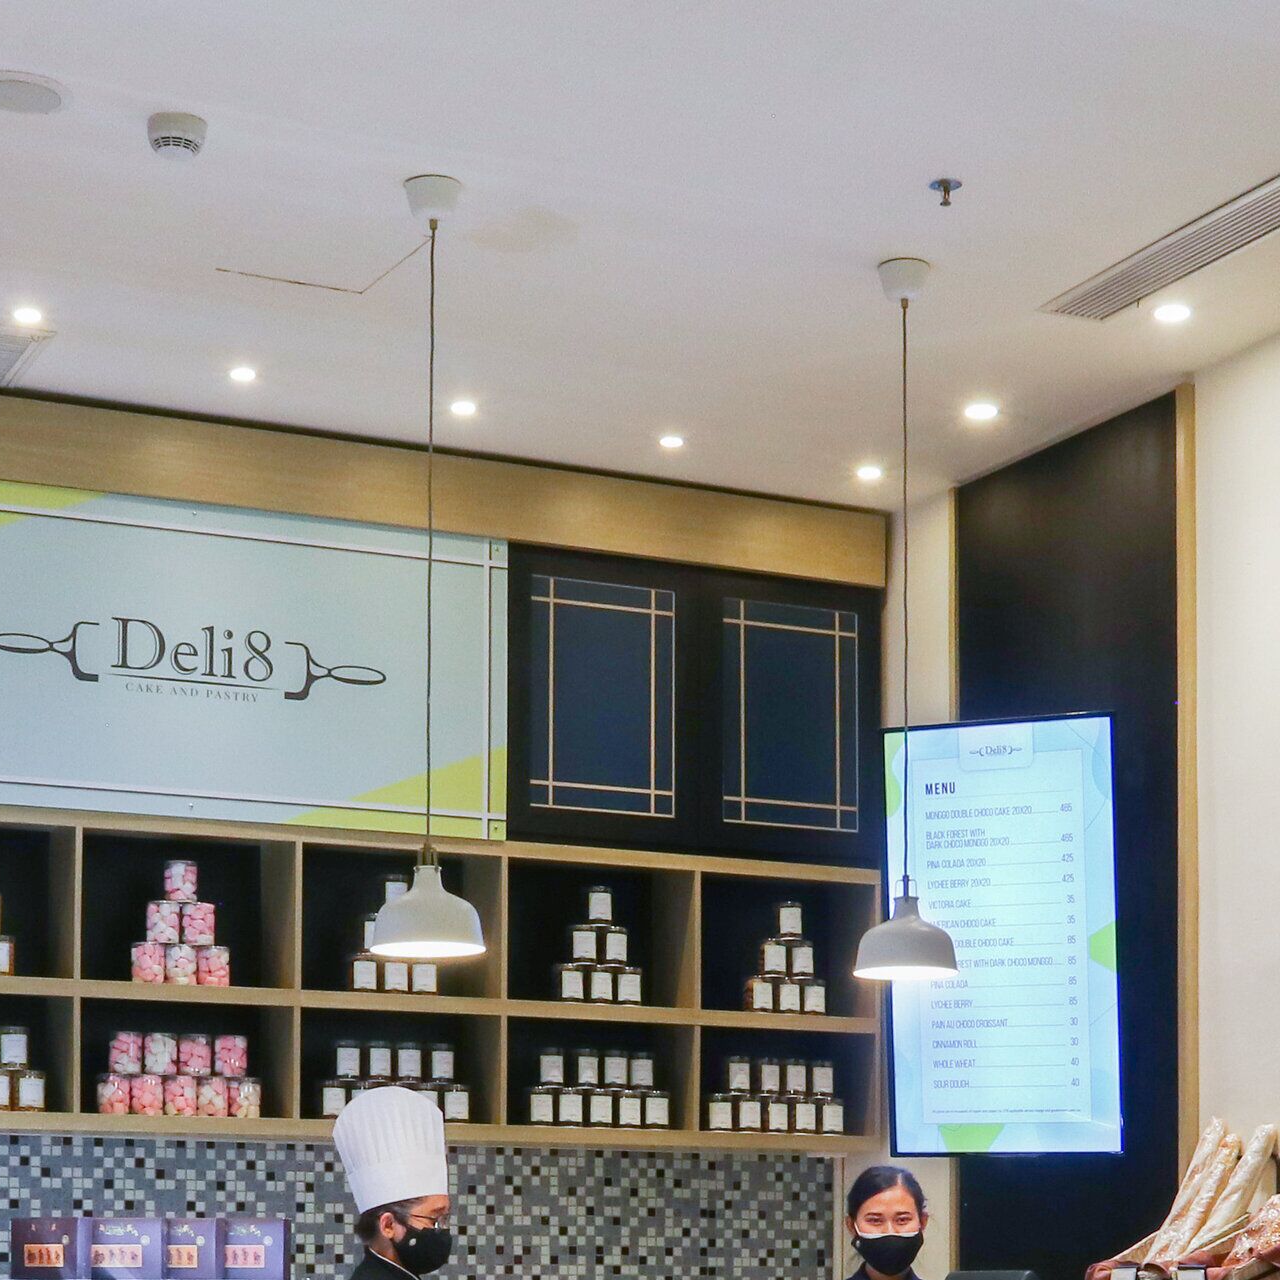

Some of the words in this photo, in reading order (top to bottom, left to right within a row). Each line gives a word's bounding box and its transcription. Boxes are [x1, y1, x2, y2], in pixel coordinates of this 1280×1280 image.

[111, 617, 274, 682] Deli8
[125, 682, 164, 694] CAKE
[170, 686, 199, 697] AND
[206, 690, 259, 703] PASTRY
[925, 781, 956, 795] MENU
[951, 809, 973, 819] DOUBLE
[974, 808, 994, 818] CHOCO
[994, 806, 1011, 816] CAKE
[926, 830, 946, 841] BLACK
[946, 829, 968, 839] FOREST
[969, 828, 986, 838] WITH
[926, 840, 944, 850] DARK
[944, 839, 963, 849] CHOCO
[941, 859, 965, 869] COLADA
[927, 880, 950, 890] LYCHEE
[950, 879, 970, 889] BERRY
[928, 900, 955, 910] VICTORIA
[955, 899, 972, 909] CAKE
[1066, 894, 1076, 904] 35
[961, 919, 980, 928] CHOCO
[980, 918, 997, 928] CAKE
[1066, 914, 1076, 924] 35
[977, 938, 998, 948] CHOCO
[998, 937, 1014, 947] CAKE
[973, 958, 990, 968] WITH
[989, 958, 1007, 968] DARK
[1007, 957, 1028, 967] CHOCO
[945, 979, 969, 989] COLADA
[931, 1000, 953, 1009] LYCHEE
[953, 999, 974, 1009] BERRY
[931, 1020, 946, 1030] PAIN
[955, 1019, 976, 1029] CHOCO
[975, 1019, 1008, 1029] CROISSANT
[1069, 1016, 1079, 1026] 30
[932, 1040, 963, 1049] CINNAMON
[963, 1039, 978, 1049] ROLL
[1070, 1036, 1079, 1047] 30
[932, 1059, 954, 1069] WHOLE
[954, 1059, 976, 1069] WHEAT
[1070, 1057, 1080, 1067] 40
[933, 1080, 949, 1089] SOUR
[1070, 1077, 1080, 1088] 40
